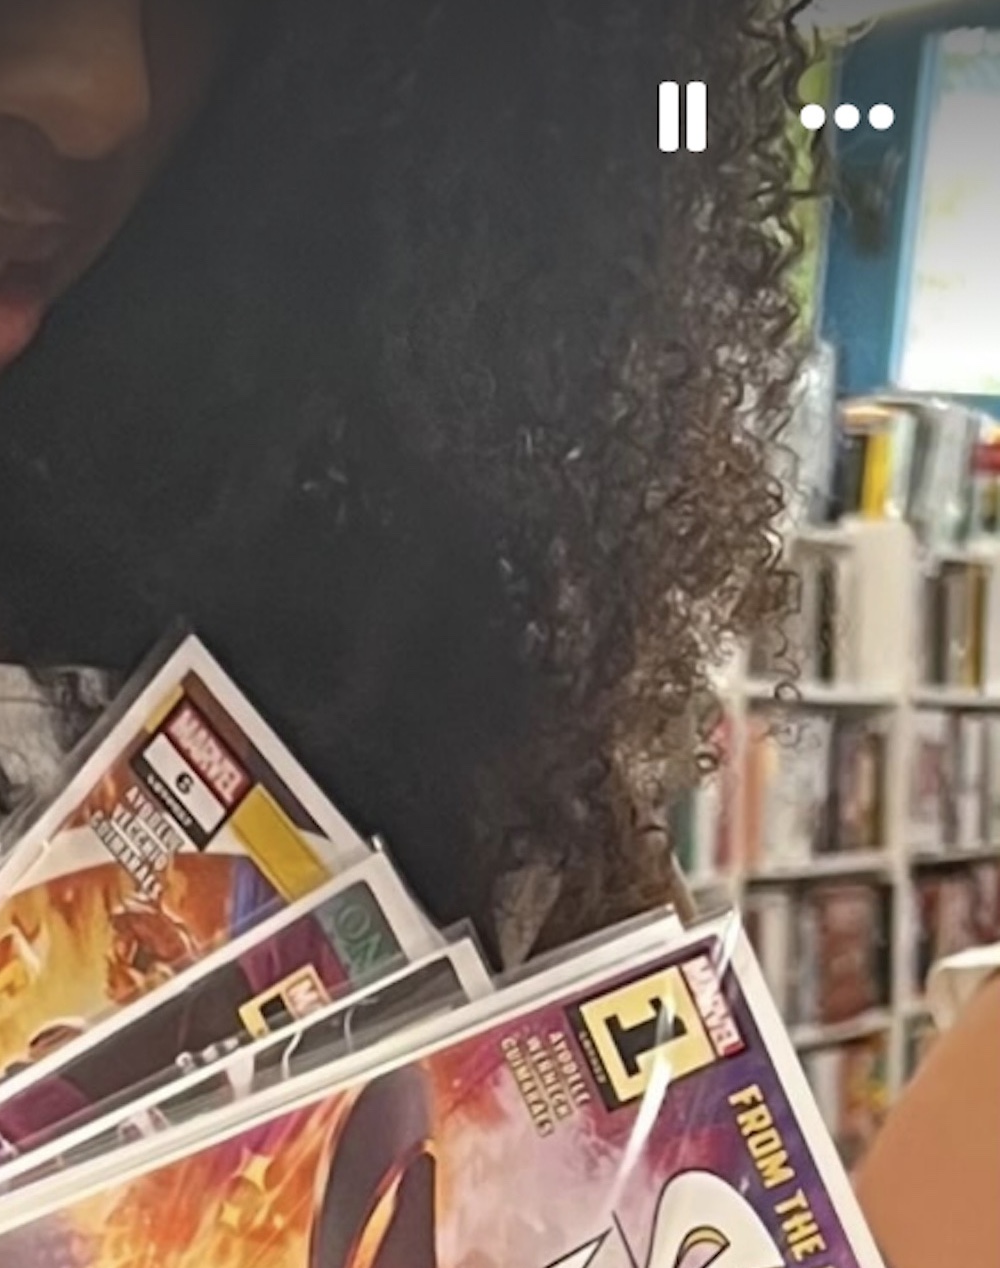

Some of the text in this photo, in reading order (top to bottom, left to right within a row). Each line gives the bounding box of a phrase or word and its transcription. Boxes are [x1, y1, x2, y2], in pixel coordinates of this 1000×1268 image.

[168, 708, 245, 804] MARVEL
[172, 770, 196, 795] 6
[604, 995, 687, 1076] 1
[729, 1083, 793, 1190] FROM
[775, 1189, 825, 1262] THE
